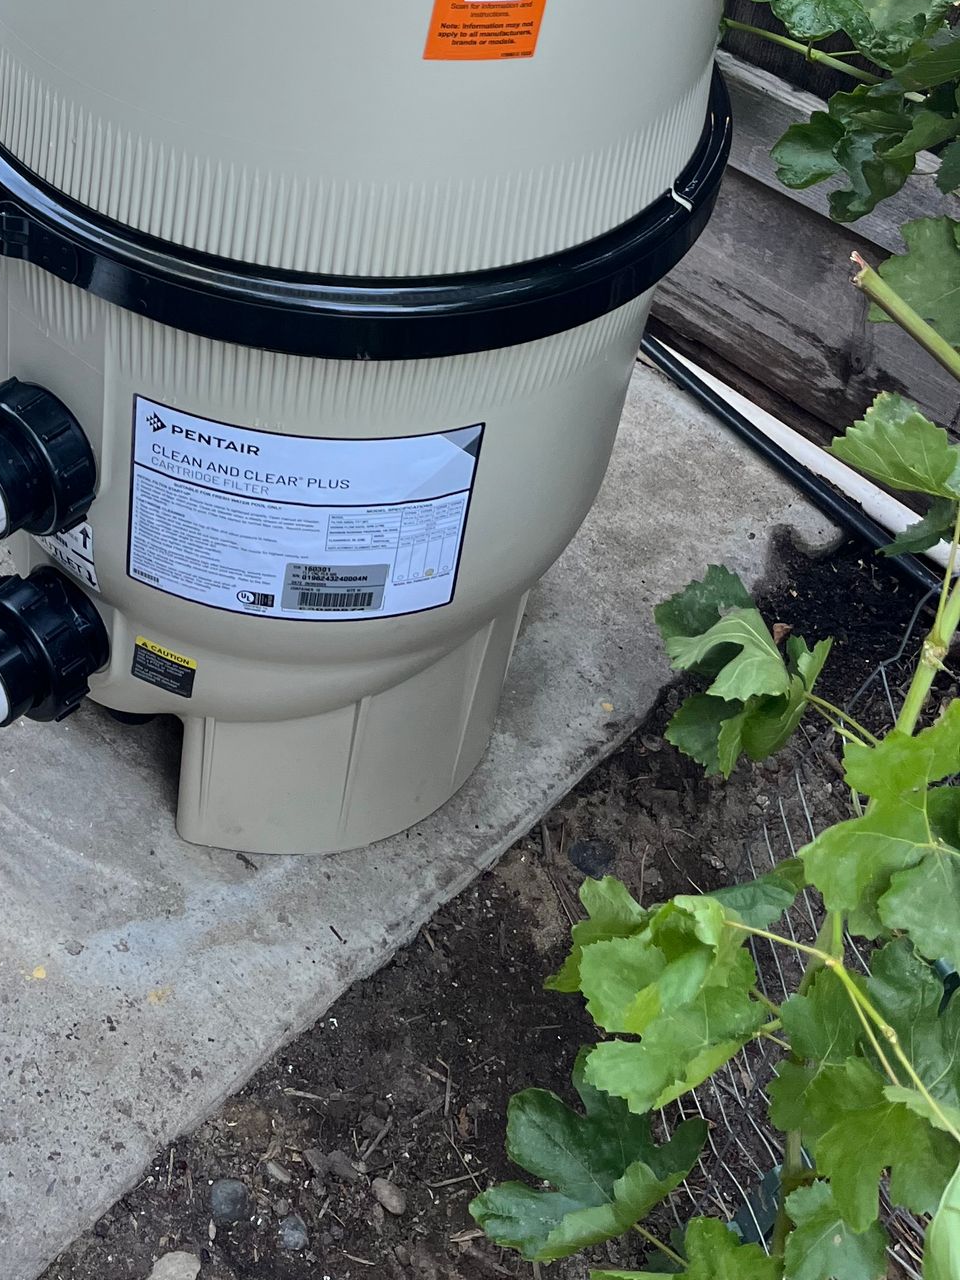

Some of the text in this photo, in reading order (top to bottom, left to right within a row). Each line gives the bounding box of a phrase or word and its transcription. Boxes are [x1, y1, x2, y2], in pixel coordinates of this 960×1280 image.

[171, 424, 260, 456] PENTAIR
[151, 456, 270, 496] CARTRIDGE FILTER
[152, 443, 202, 468] CLEAN
[206, 462, 240, 477] AND
[307, 477, 351, 490] PLUS
[150, 644, 190, 666] CAUTION
